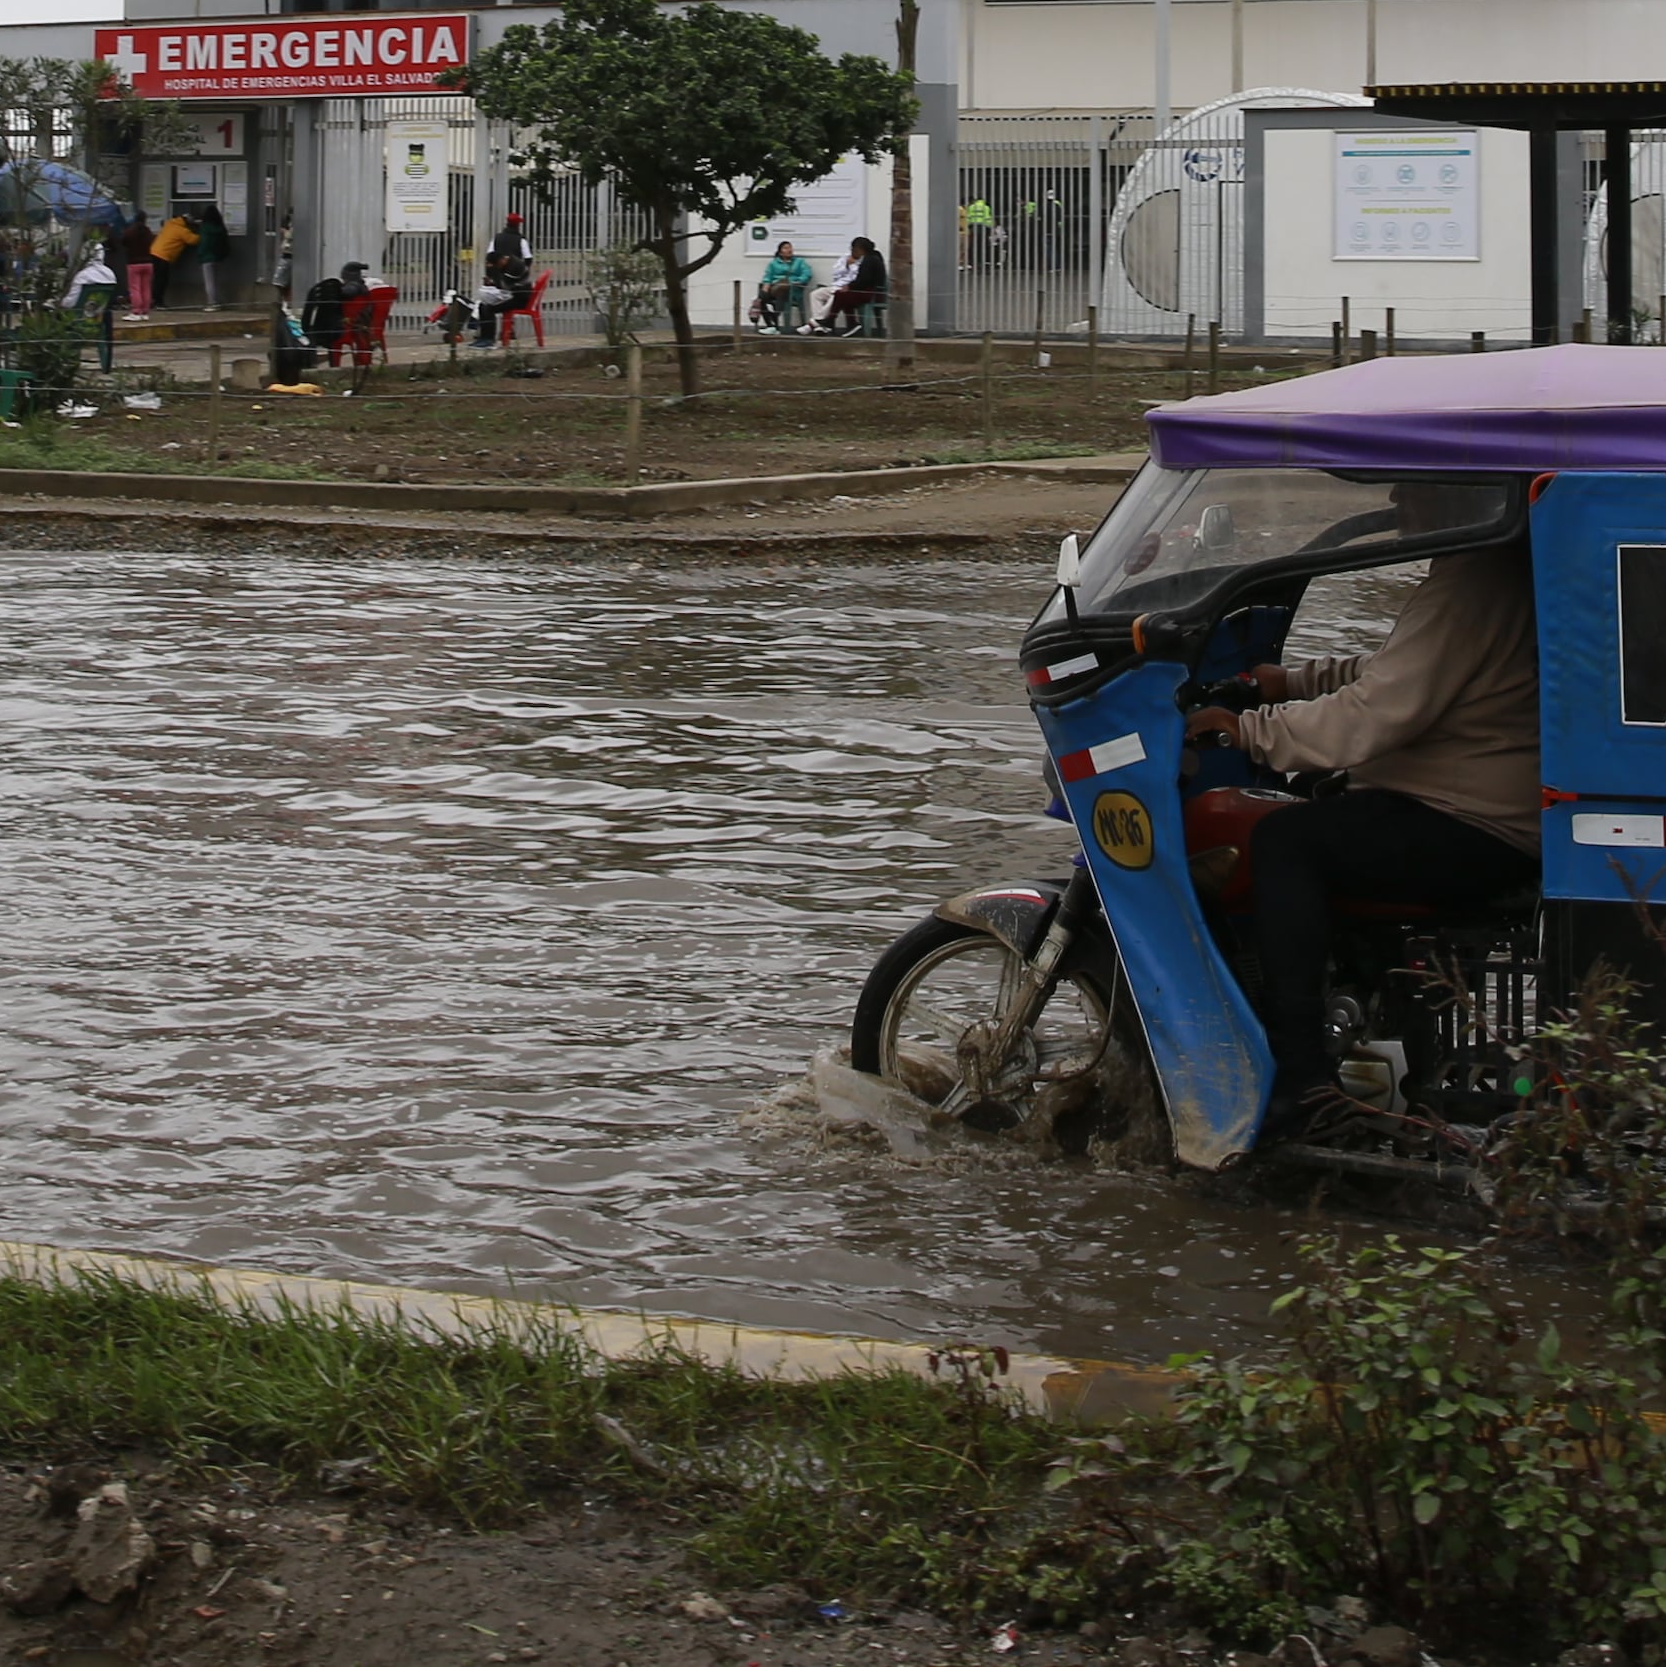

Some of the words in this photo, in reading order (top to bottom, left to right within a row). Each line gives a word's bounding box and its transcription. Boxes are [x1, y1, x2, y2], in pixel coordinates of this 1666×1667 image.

[158, 26, 459, 71] EMERGENCIA
[164, 77, 220, 90] HOSPITAL
[222, 77, 239, 89] DE
[241, 75, 326, 89] EMERGENCIAS
[329, 74, 364, 87] VILLA
[366, 74, 382, 86] EL
[217, 119, 233, 149] 1
